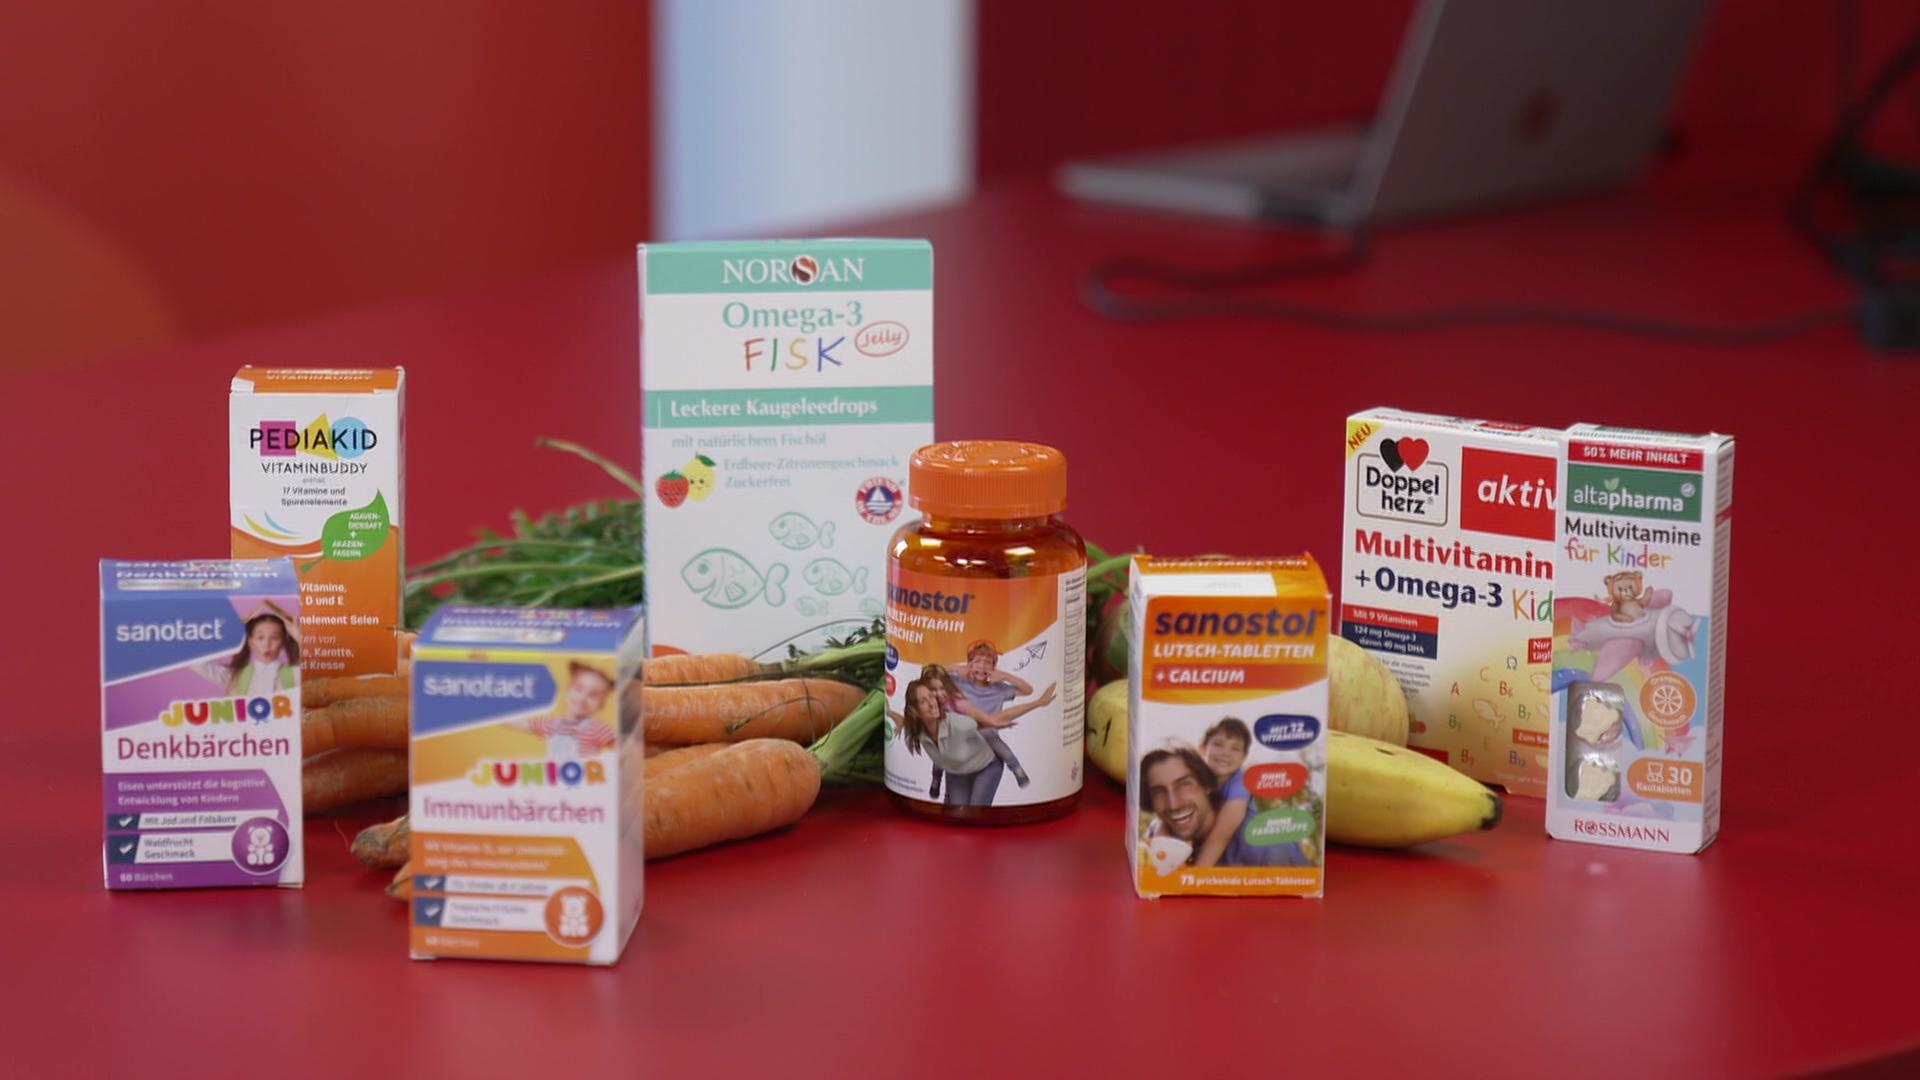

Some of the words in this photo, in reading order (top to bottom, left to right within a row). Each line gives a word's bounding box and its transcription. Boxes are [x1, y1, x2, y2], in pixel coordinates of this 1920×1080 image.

[722, 254, 865, 285] NORSAN
[722, 301, 863, 334] Omega-3
[744, 337, 845, 372] FISK
[670, 400, 742, 417] Leckere
[746, 398, 878, 419] Kaugeleedrops
[250, 429, 378, 450] PEDIAKID
[672, 435, 695, 448] mit
[698, 434, 777, 448] natürlichem
[1347, 424, 1373, 451] NEU
[1610, 448, 1643, 461] MEHR
[1647, 452, 1689, 464] INHALT
[260, 463, 368, 475] VITAMINBUDDY
[283, 487, 290, 495] 17
[292, 487, 328, 495] Vitamine
[330, 487, 346, 495] und
[725, 476, 791, 488] Zuckerfrei
[1366, 467, 1440, 496] Doppel
[1477, 474, 1557, 510] aktiv
[281, 498, 348, 507] Spurenelemente
[1381, 491, 1426, 515] herz
[1573, 484, 1684, 512] altapharma
[1565, 516, 1701, 546] Multivitamine
[1355, 529, 1554, 580] Multivitamin
[1565, 538, 1600, 563] für
[1607, 543, 1673, 569] Kinder
[315, 596, 335, 605] und
[887, 584, 970, 614] anostol
[116, 619, 223, 642] sanotact
[350, 615, 380, 625] Selen
[1154, 608, 1318, 637] sanostol
[1377, 613, 1418, 626] Vitaminen
[1153, 643, 1315, 659] LUTSCH-TABLETTEN
[1533, 641, 1550, 649] Nur
[424, 674, 534, 698] sanotact
[1169, 669, 1245, 684] CALCIUM
[1451, 681, 1460, 696] A
[162, 695, 293, 726] JUNIOR
[118, 733, 290, 760] Denkbärchen
[118, 781, 144, 791] Eisen
[203, 779, 218, 789] die
[471, 761, 606, 786] JUNIOR
[1667, 767, 1693, 785] 30
[424, 799, 604, 823] Immunbärchen
[1575, 820, 1670, 843] ROSSMANN
